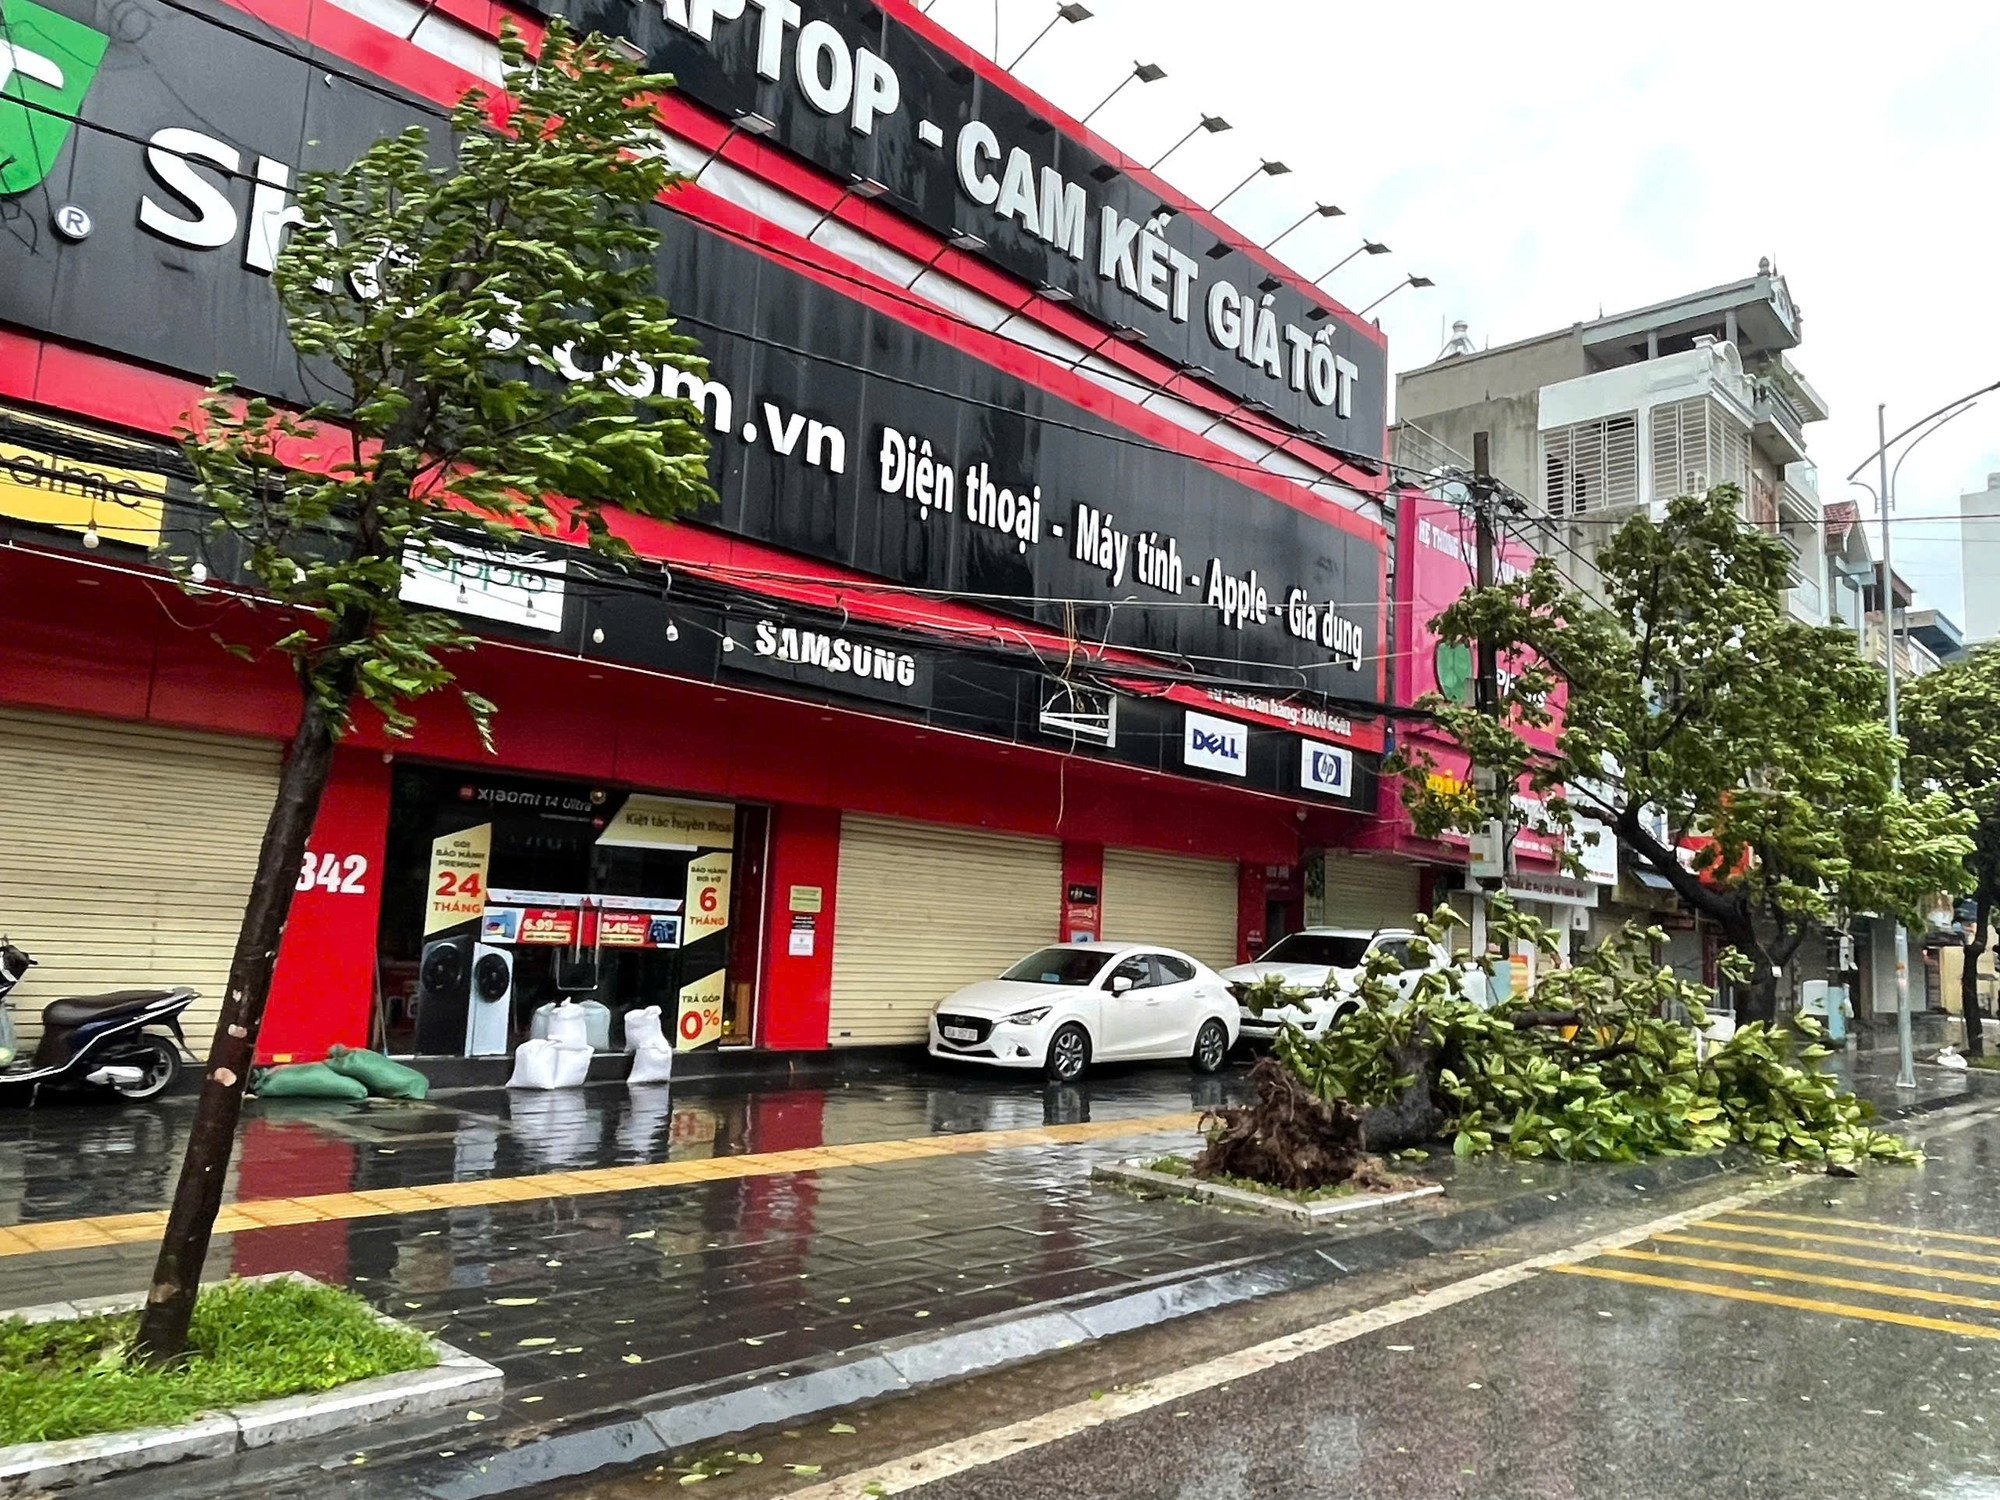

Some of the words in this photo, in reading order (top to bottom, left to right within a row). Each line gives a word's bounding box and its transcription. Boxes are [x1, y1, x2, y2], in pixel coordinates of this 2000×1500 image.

[956, 120, 1086, 260] CAM
[1099, 212, 1199, 323] KẾT
[1207, 280, 1282, 379] GIÁ
[1284, 323, 1358, 419] TỐT
[880, 426, 955, 521] Điện
[966, 462, 1041, 554] thoại
[1076, 503, 1129, 588] Máy
[1137, 531, 1182, 595] tính
[1207, 557, 1268, 630] Apple
[1288, 588, 1317, 641] Gia
[1322, 600, 1363, 672] dụng
[755, 620, 915, 687] SAMSUNG
[1301, 707, 1327, 729] 1800
[1192, 728, 1239, 760] DELL
[295, 851, 368, 895] 342
[435, 871, 482, 898] 24
[433, 901, 481, 914] THÁNG
[700, 887, 718, 912] 6
[689, 914, 725, 926] THÁNG
[680, 1008, 720, 1041] 0%
